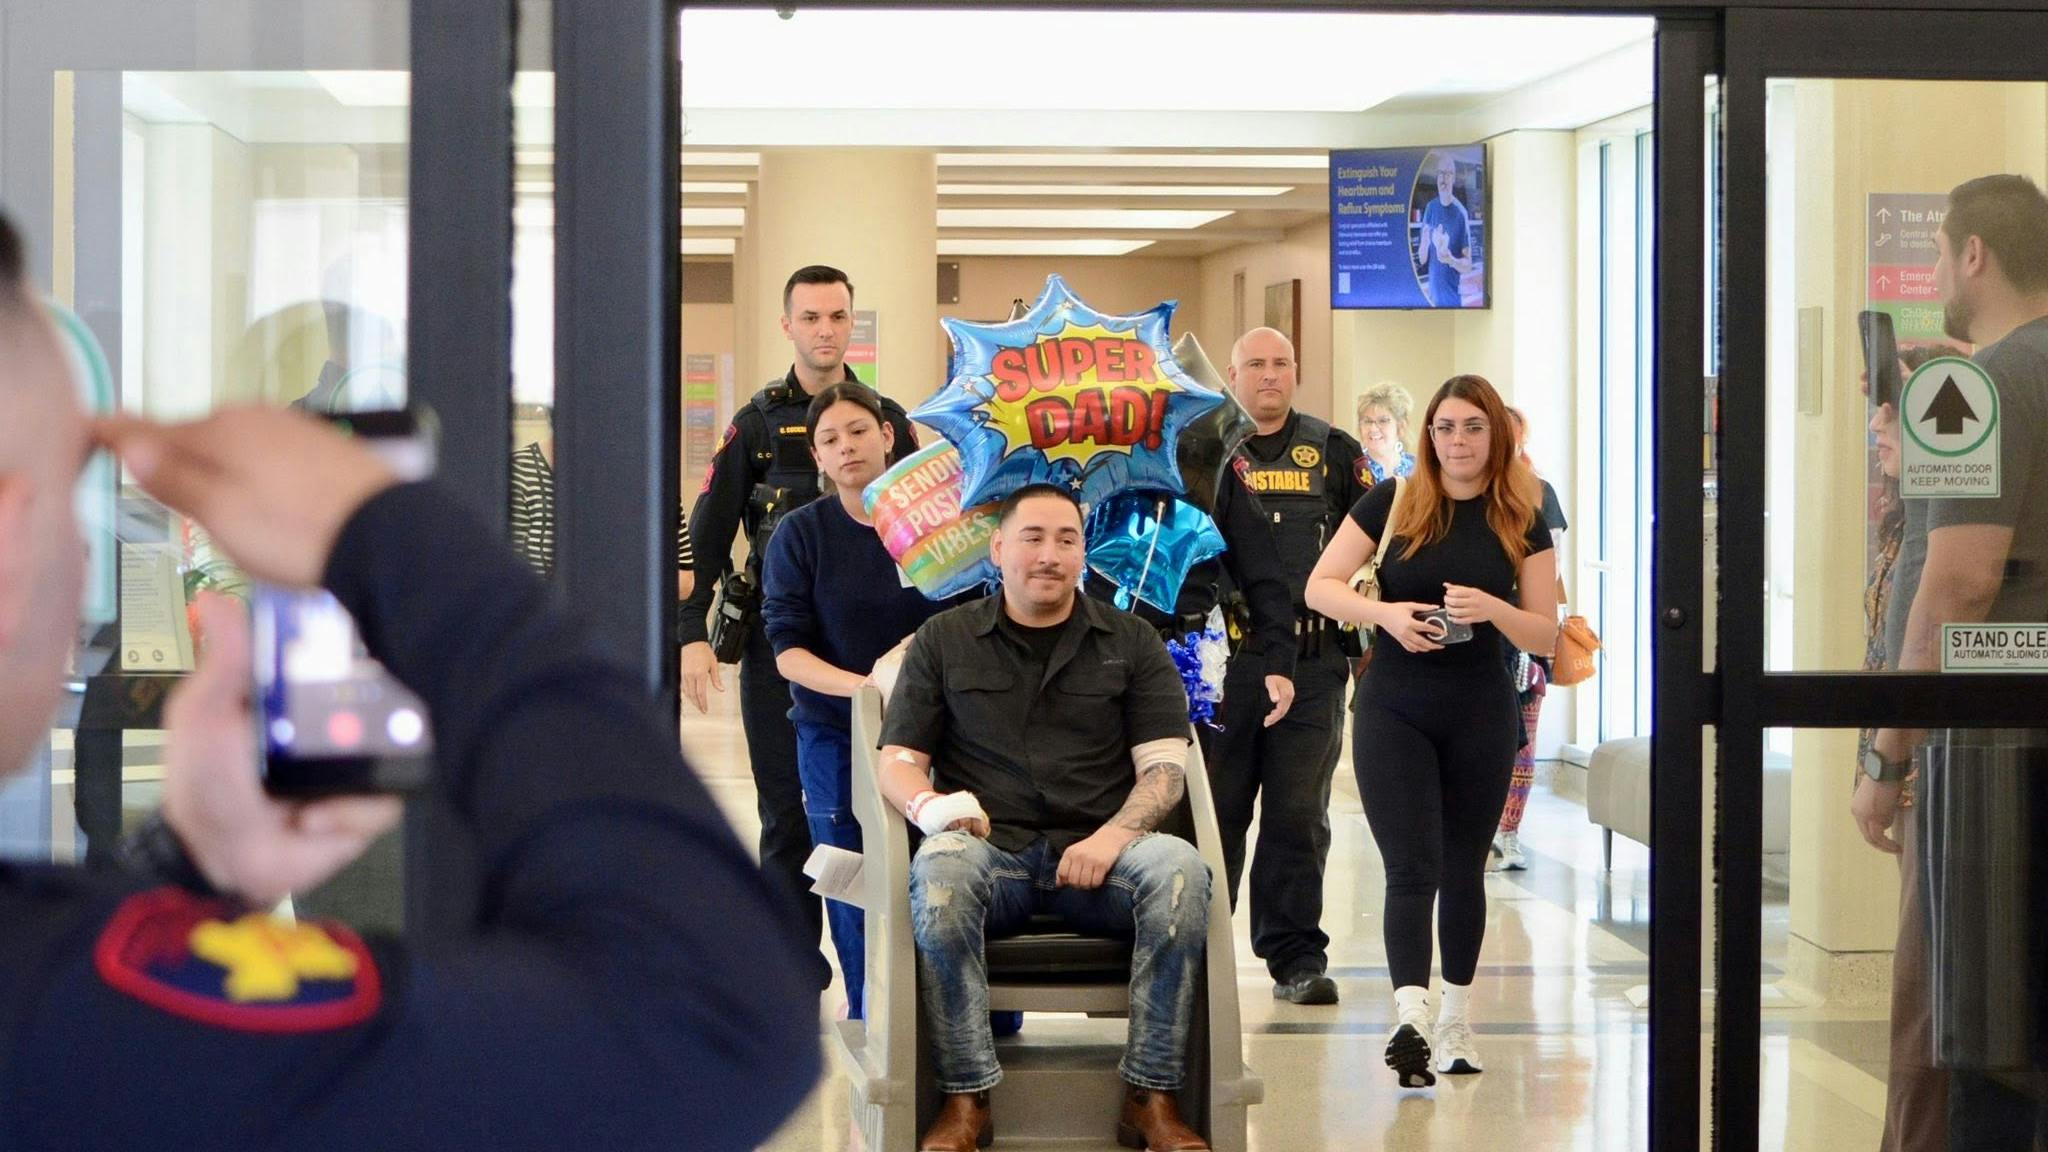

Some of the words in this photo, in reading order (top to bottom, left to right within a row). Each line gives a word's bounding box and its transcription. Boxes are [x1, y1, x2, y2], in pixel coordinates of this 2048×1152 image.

[1338, 166, 1378, 181] Extinguish
[1379, 166, 1397, 177] Your
[1338, 184, 1377, 197] Heartburn
[1379, 183, 1394, 196] and
[1338, 202, 1362, 215] Reflux
[1363, 202, 1405, 217] Symptoms
[1900, 209, 1922, 223] The
[1926, 209, 1948, 223] Atr
[1900, 284, 1931, 296] Center
[991, 336, 1158, 403] SUPER
[1025, 385, 1171, 451] DAD!
[1907, 463, 1962, 474] AUTOMATIC
[1964, 463, 1992, 474] DOOR
[1910, 476, 1940, 487] KEEP
[1944, 476, 1990, 487] MOVING
[924, 511, 993, 565] VIBES
[1952, 630, 2008, 648] STAND
[2014, 630, 2048, 648] CLE
[1953, 649, 2004, 659] AUTOMATIC
[2006, 649, 2041, 659] SLIDING
[2042, 650, 2048, 659] D
